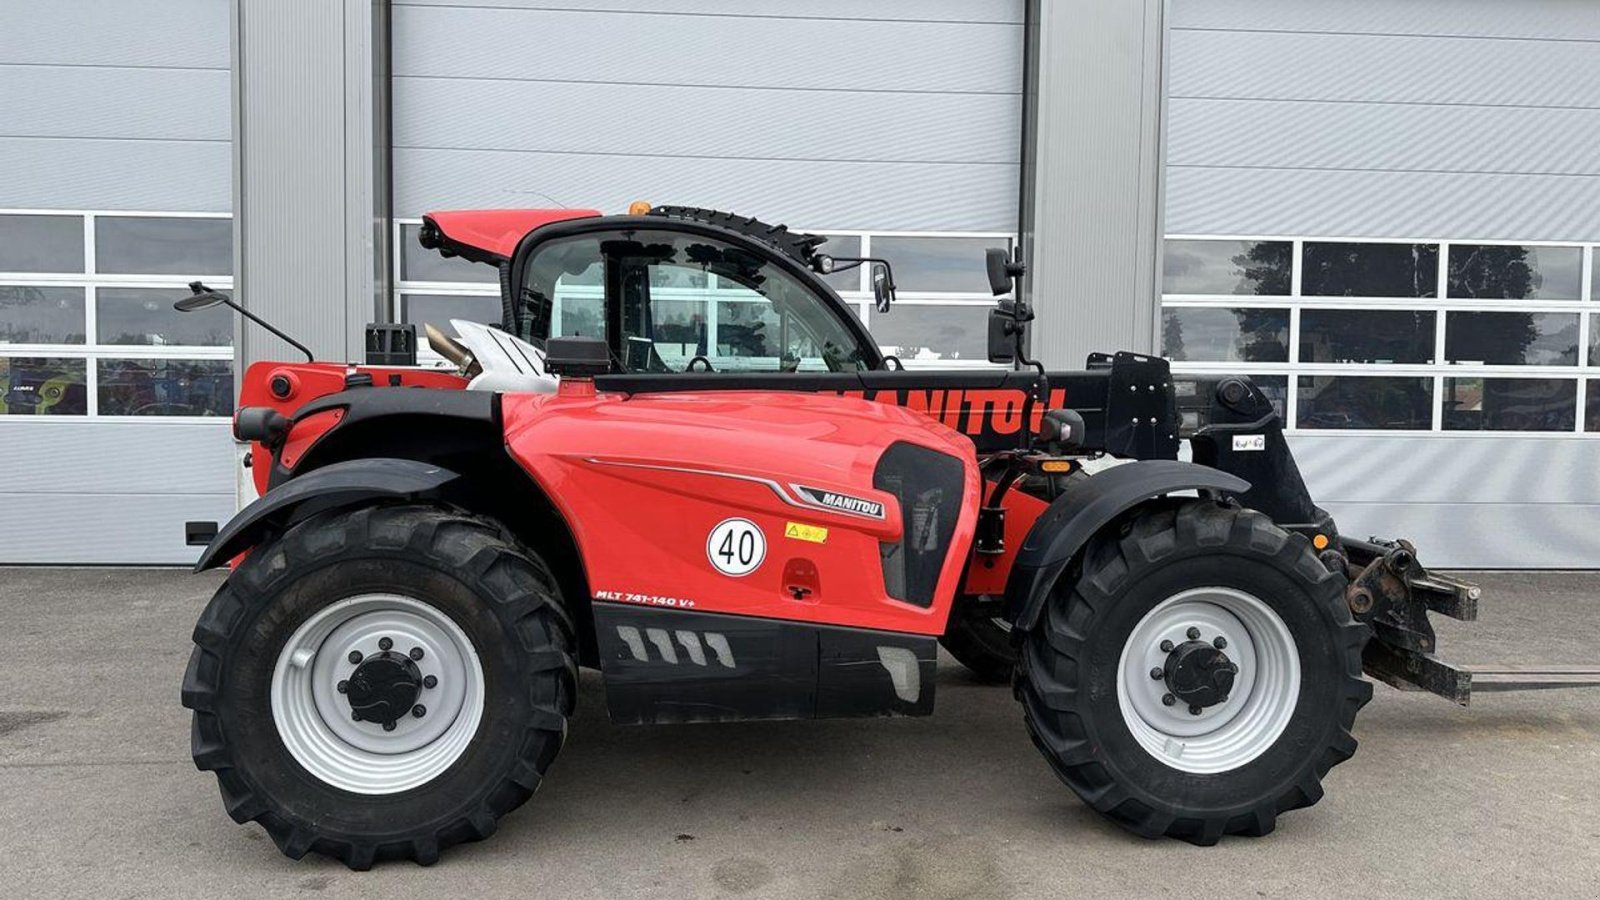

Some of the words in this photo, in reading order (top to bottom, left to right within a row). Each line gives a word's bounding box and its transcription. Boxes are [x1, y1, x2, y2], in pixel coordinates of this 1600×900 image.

[822, 493, 880, 514] MANITOU
[718, 528, 755, 566] 40
[596, 590, 623, 601] MLT
[625, 593, 676, 606] 741-140
[679, 599, 695, 607] V+
